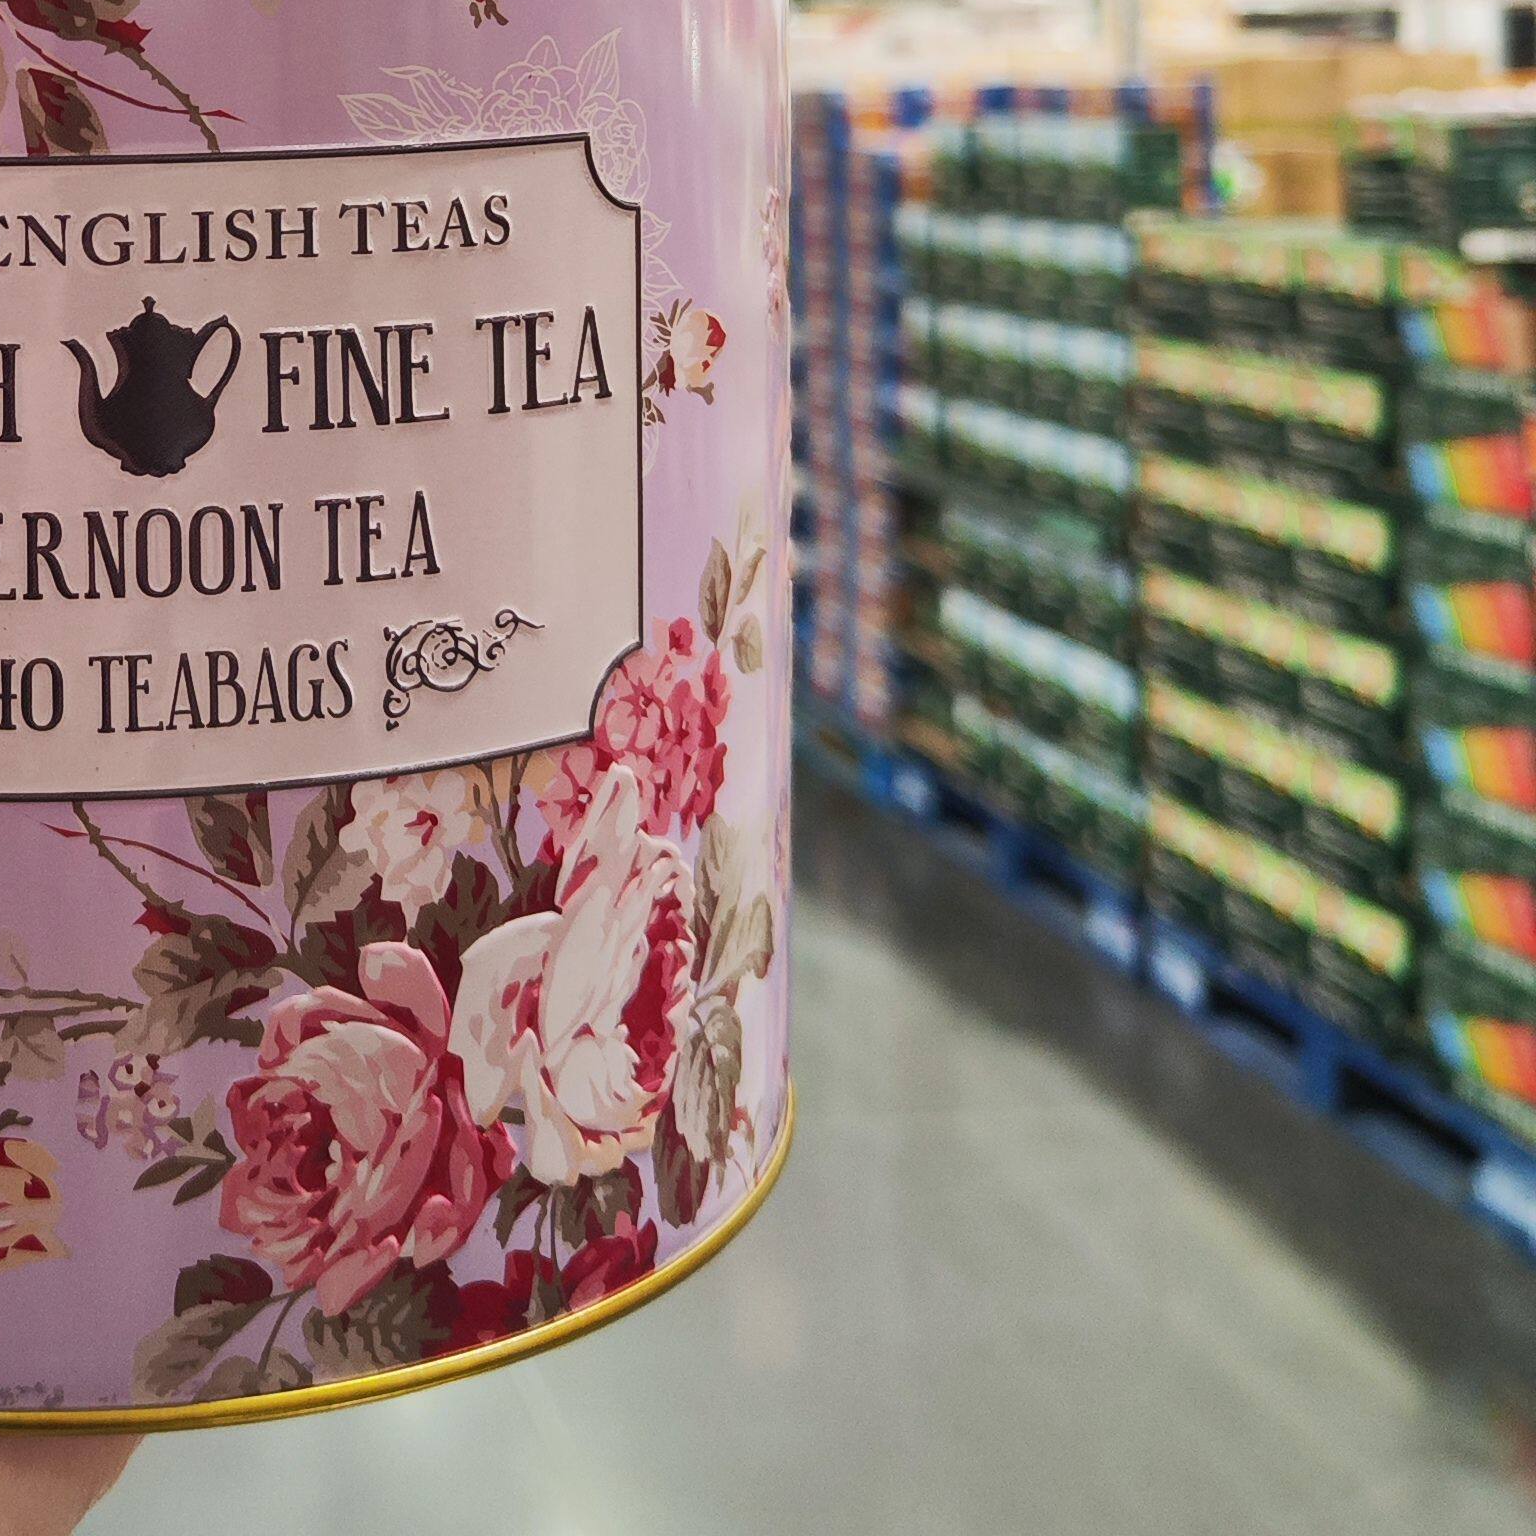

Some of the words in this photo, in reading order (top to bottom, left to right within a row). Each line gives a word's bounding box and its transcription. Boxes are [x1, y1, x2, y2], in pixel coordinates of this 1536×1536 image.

[338, 195, 510, 255] TEAS
[259, 323, 450, 434] FINE
[475, 306, 612, 415] TEA
[314, 491, 441, 586] TEA
[88, 641, 353, 734] TEABAGS
